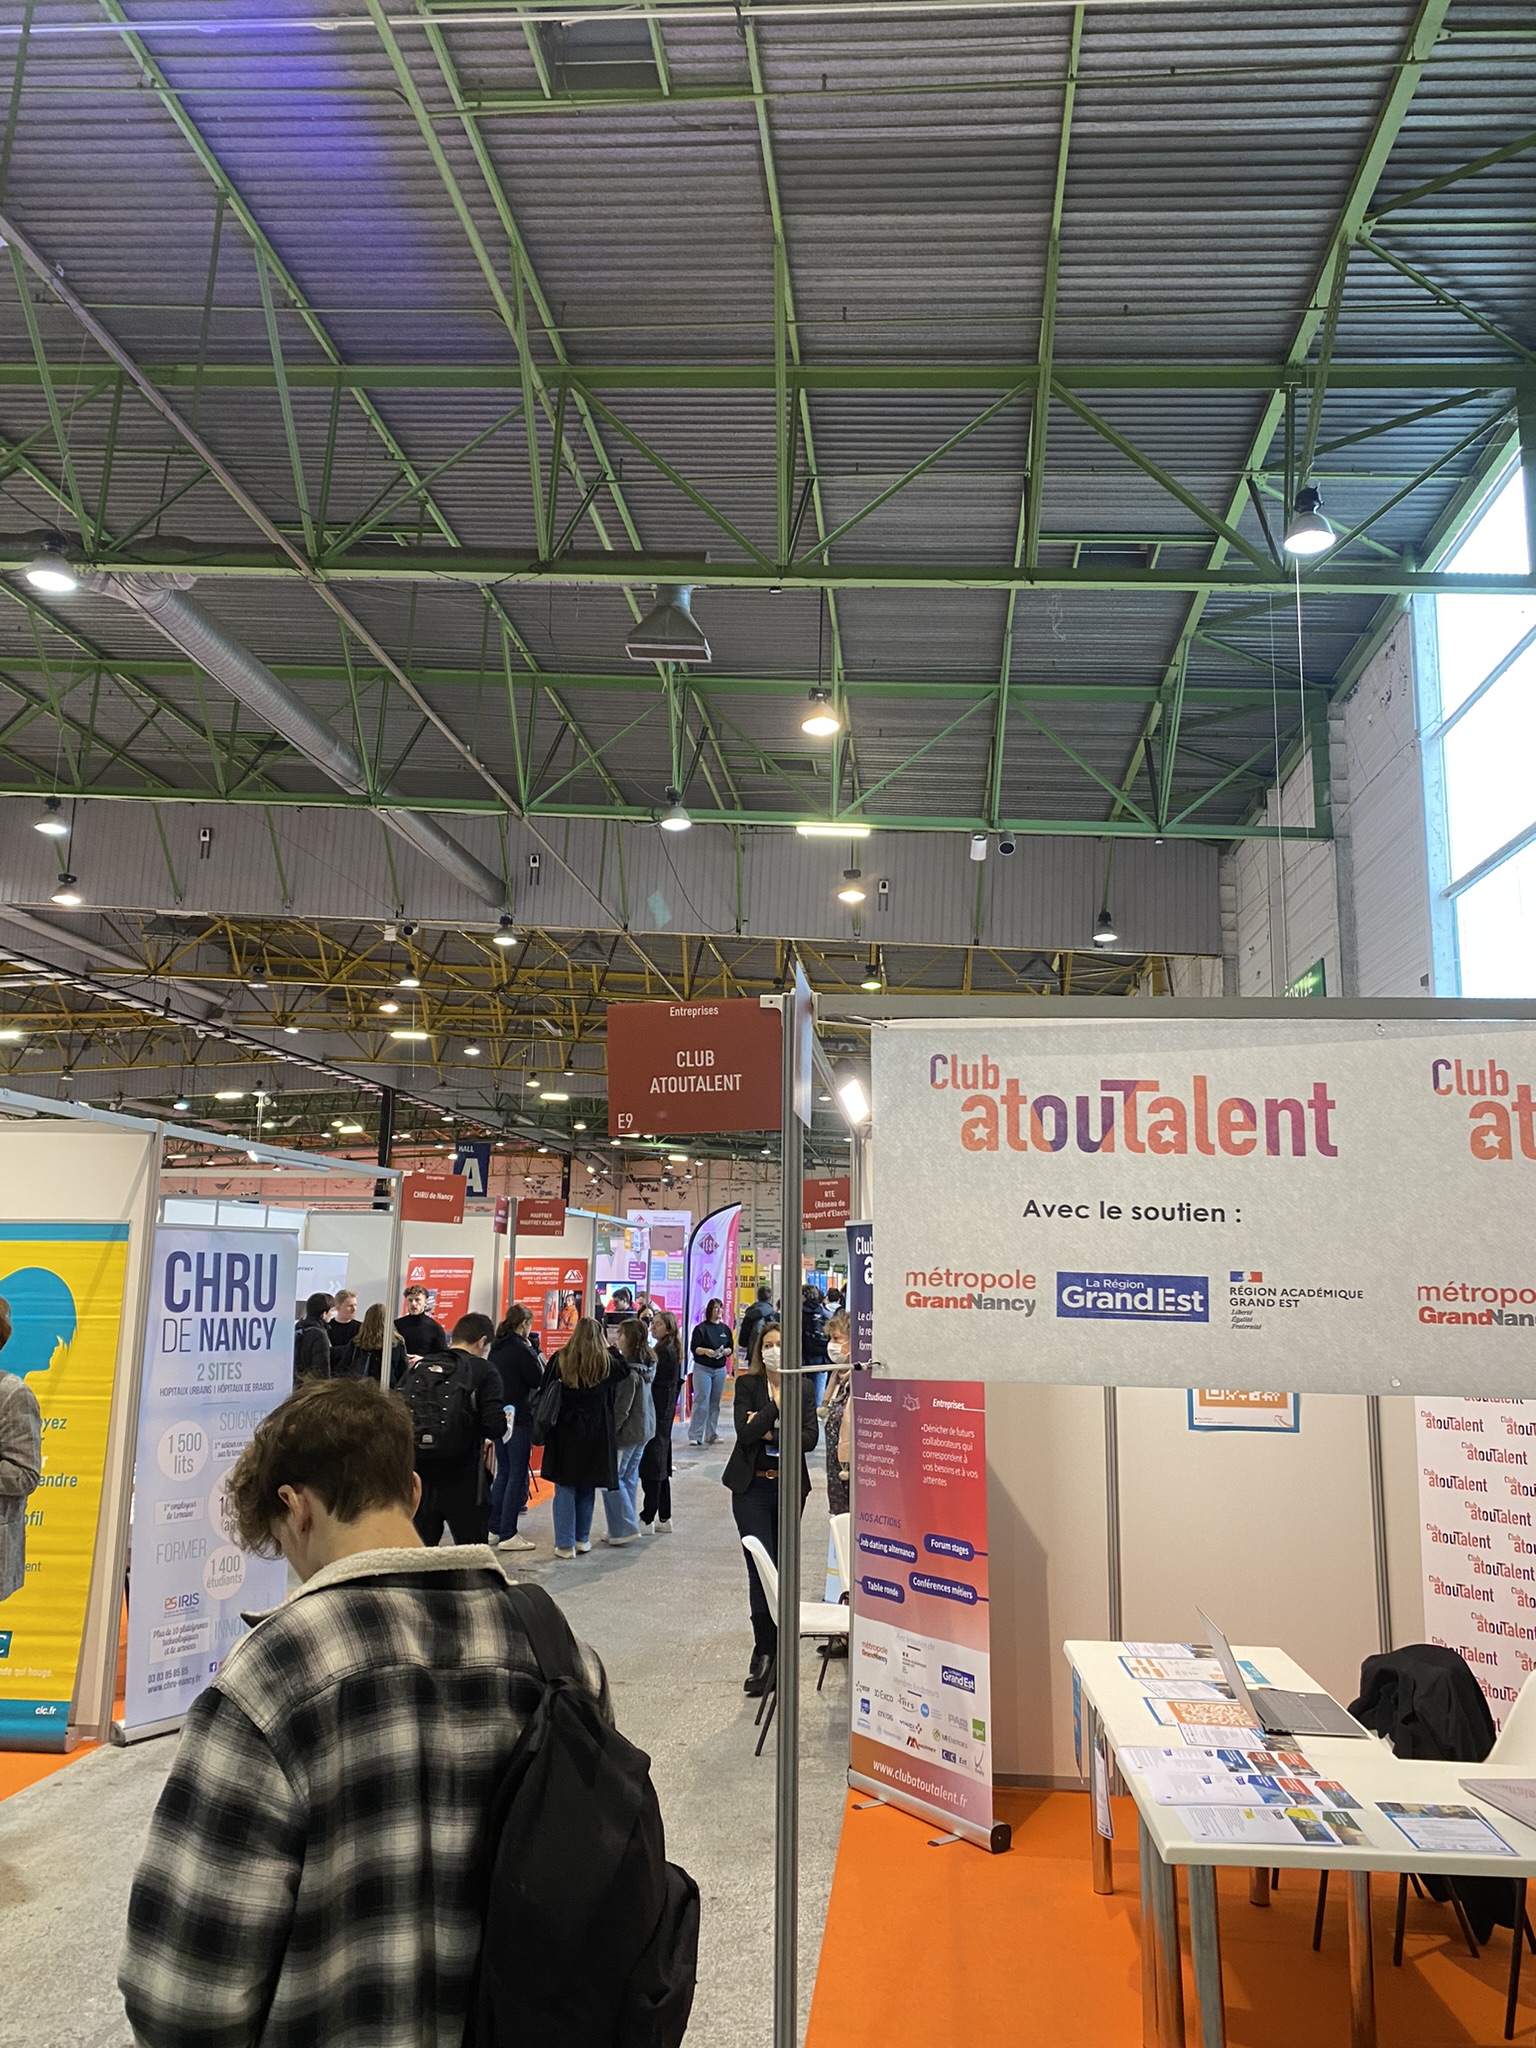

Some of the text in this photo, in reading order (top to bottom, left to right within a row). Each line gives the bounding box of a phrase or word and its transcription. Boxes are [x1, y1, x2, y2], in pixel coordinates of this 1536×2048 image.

[1285, 972, 1313, 997] ORTIE
[670, 1006, 719, 1018] Entreprises
[676, 1050, 714, 1068] CLUB
[930, 1054, 1000, 1090] Club
[1432, 1058, 1510, 1096] Club
[650, 1074, 742, 1094] ATOUTALENT
[618, 1113, 633, 1128] E9
[961, 1075, 1338, 1157] atouTalent
[460, 1157, 483, 1193] A
[413, 1191, 429, 1199] CHRU
[436, 1193, 454, 1202] Nancy
[825, 1190, 835, 1198] RTE
[815, 1200, 837, 1209] (Réseau
[1023, 1199, 1090, 1219] Avec
[1100, 1200, 1122, 1220] le
[1131, 1202, 1225, 1223] soutien
[803, 1209, 850, 1221] ransport d'Electri
[164, 1251, 277, 1313] CHRU
[906, 1267, 1036, 1293] métropole
[1086, 1278, 1144, 1290] La Région
[1230, 1285, 1364, 1300] RÉGION ACADÉMIQUE
[1417, 1281, 1536, 1308] métropo
[1230, 1298, 1300, 1308] GRAND EST
[1418, 1306, 1536, 1326] GrandNan
[162, 1317, 276, 1353] DE NANCY
[197, 1362, 242, 1381] 2 SITES
[190, 1385, 212, 1395] URBAINS
[244, 1383, 251, 1392] DE
[252, 1382, 274, 1392] BRABOIS
[932, 1398, 964, 1410] Entreprises
[42, 1417, 68, 1432] yez
[924, 1423, 975, 1438] Dénicher de futurs
[1426, 1416, 1484, 1432] atouTalent
[168, 1432, 201, 1454] 1 500
[873, 1431, 883, 1439] pro
[922, 1436, 973, 1452] collaborateurs qui
[174, 1455, 194, 1474] lits
[866, 1453, 894, 1465] alternance
[922, 1451, 968, 1464] correspondent à
[1467, 1447, 1528, 1465] atouTalent
[934, 1463, 954, 1475] besoins
[955, 1467, 961, 1476] et
[961, 1467, 965, 1477] à
[966, 1470, 978, 1479] vos
[38, 1474, 78, 1488] endre
[922, 1477, 947, 1487] attentes
[1428, 1474, 1488, 1492] atouTalent
[860, 1512, 902, 1529] NOS ACTIONS
[1470, 1507, 1532, 1526] atouTalent
[860, 1537, 915, 1559] Job dating alternance
[930, 1539, 969, 1556] Forum stages
[1431, 1529, 1491, 1549] atouTalent
[156, 1538, 207, 1564] FORMER
[211, 1555, 240, 1575] 1 400
[1474, 1560, 1535, 1581] atouTalent
[206, 1573, 242, 1589] étudiants
[867, 1581, 899, 1597] Table ronde
[913, 1576, 973, 1600] Conférences métiers
[1434, 1581, 1494, 1602] atouTalent
[35, 1706, 57, 1715] cic.fr
[872, 1758, 968, 1808] www.clubatoutalent.fr
